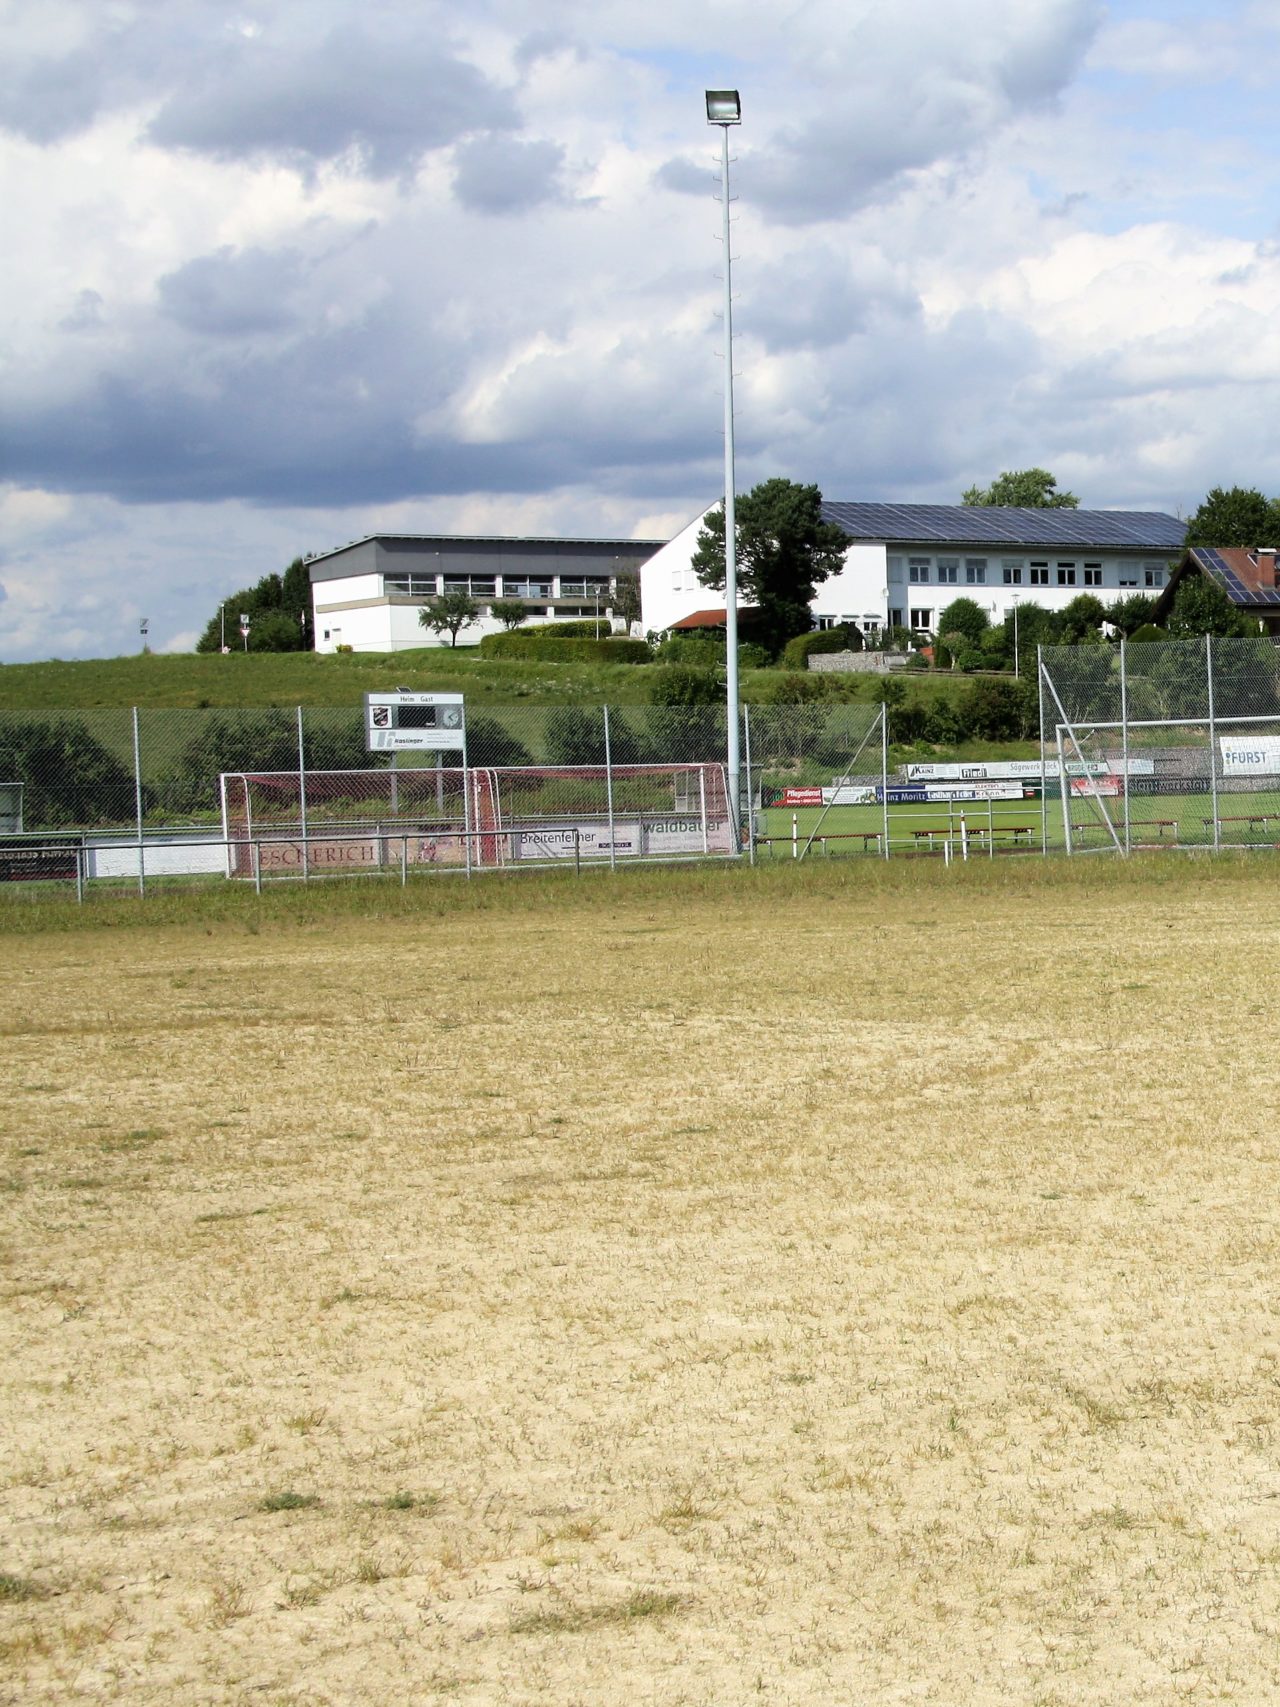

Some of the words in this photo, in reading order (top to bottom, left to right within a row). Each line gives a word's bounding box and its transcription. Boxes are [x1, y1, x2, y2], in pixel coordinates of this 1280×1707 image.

[1010, 762, 1040, 772] Sägewerk
[786, 789, 821, 798] Pflegedienst
[901, 791, 925, 800] Moritz
